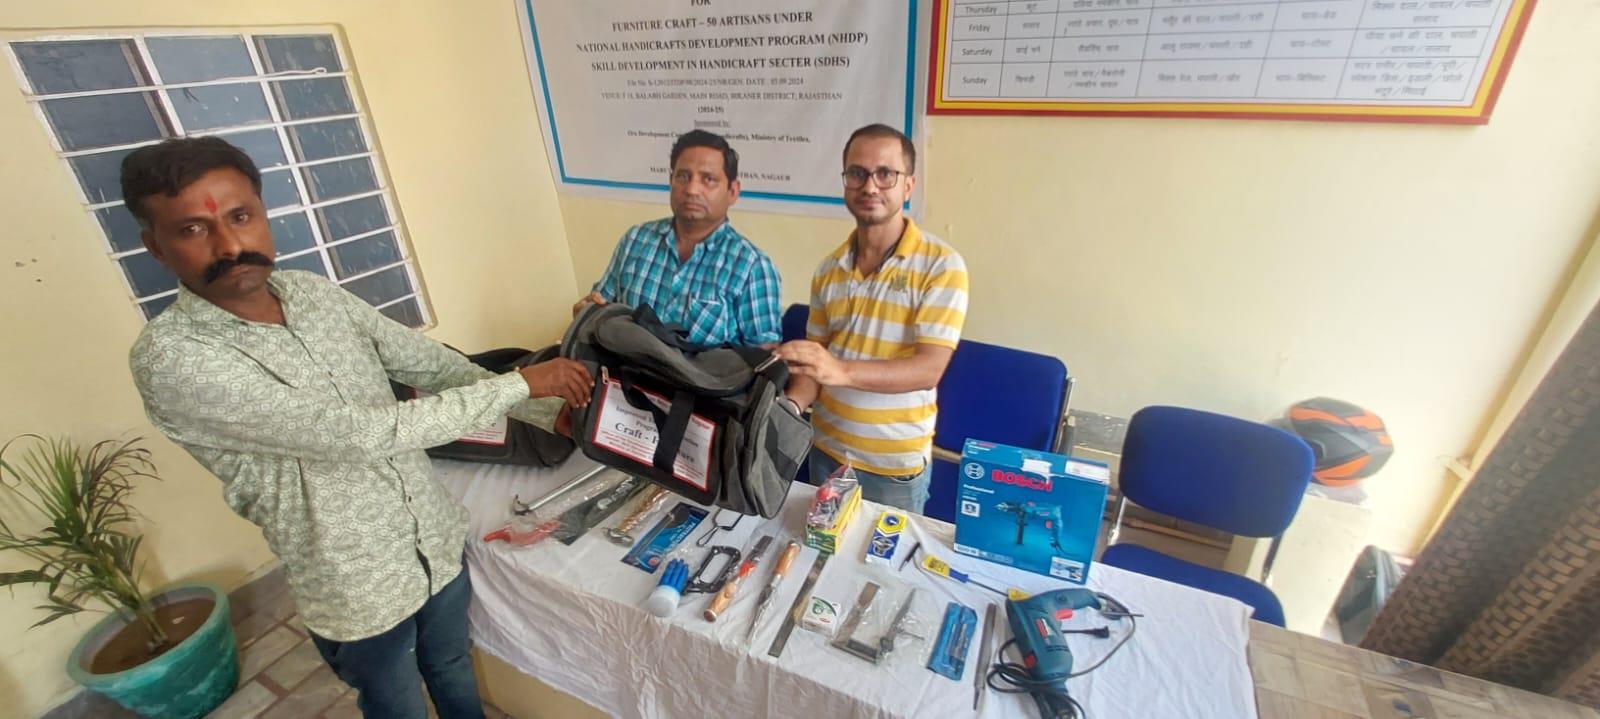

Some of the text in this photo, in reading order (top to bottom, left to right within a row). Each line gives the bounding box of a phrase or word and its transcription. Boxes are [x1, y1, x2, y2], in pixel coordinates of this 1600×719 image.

[965, 6, 997, 15] Thursday
[612, 20, 662, 32] FURNITURE
[665, 18, 696, 29] CRAFT
[707, 17, 717, 27] 50
[720, 14, 771, 26] ARTISANS
[774, 11, 813, 23] UNDER
[968, 23, 991, 33] Friday
[576, 32, 869, 53] NATIONAL HANDICRAFTS DEVELOPMENT PROGRAM (NHDP)
[962, 47, 993, 56] Saturday
[592, 56, 850, 71] SKILL DEVELOPMENT IN HANDICRAFT SECTER (SDHS)
[746, 78, 765, 86] DATE
[962, 76, 988, 85] Sunday
[731, 92, 761, 100] BIKANER
[799, 92, 842, 100] RAJASTHAN
[615, 422, 642, 439] Craft
[991, 469, 1053, 493] BOSCH
